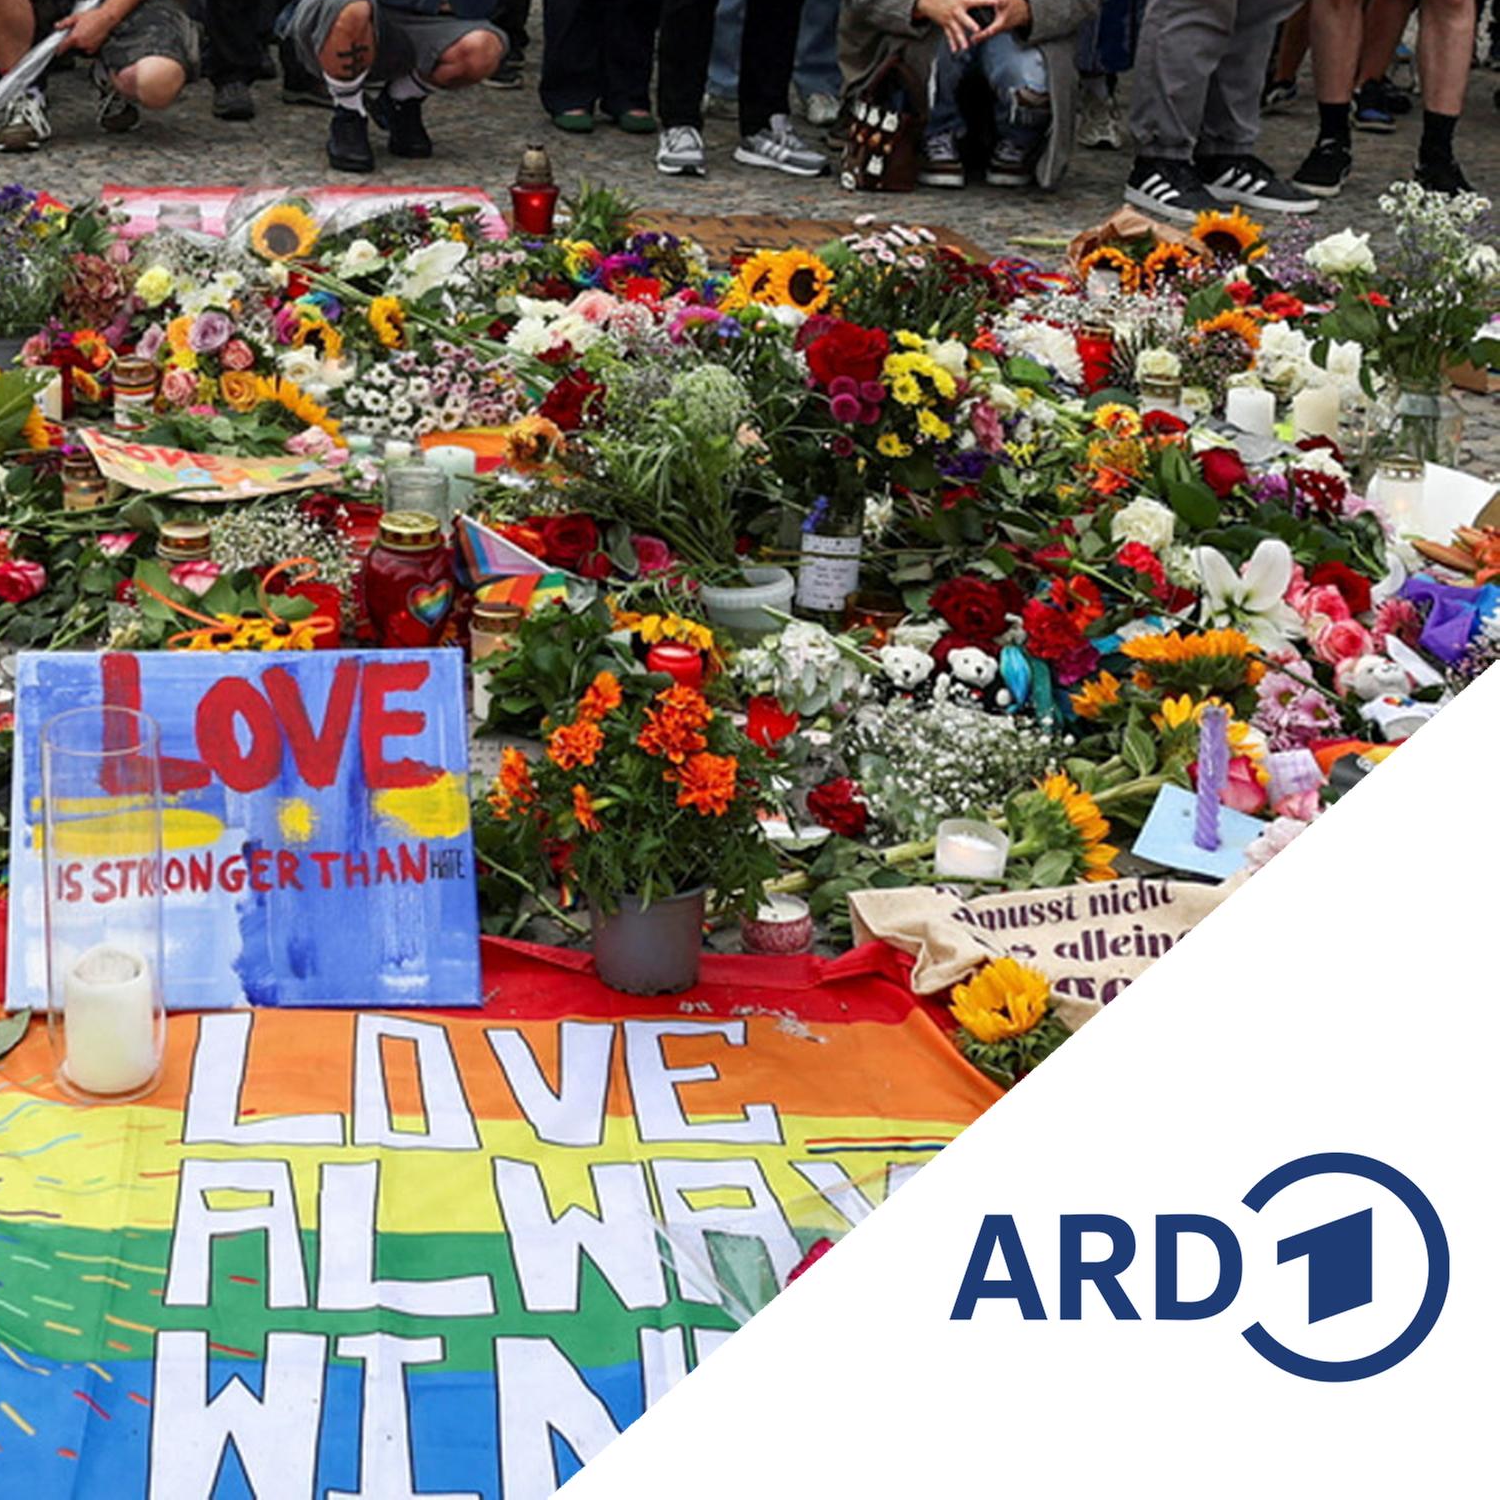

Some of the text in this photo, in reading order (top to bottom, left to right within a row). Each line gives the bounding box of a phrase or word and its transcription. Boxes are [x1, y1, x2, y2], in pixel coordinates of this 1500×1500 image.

[97, 652, 446, 796] LOVE
[56, 843, 467, 903] IS STRONGER THAN HATE
[1089, 878, 1176, 918] nicht
[182, 1011, 787, 1152] LOVE
[148, 1326, 740, 1500] WIN
